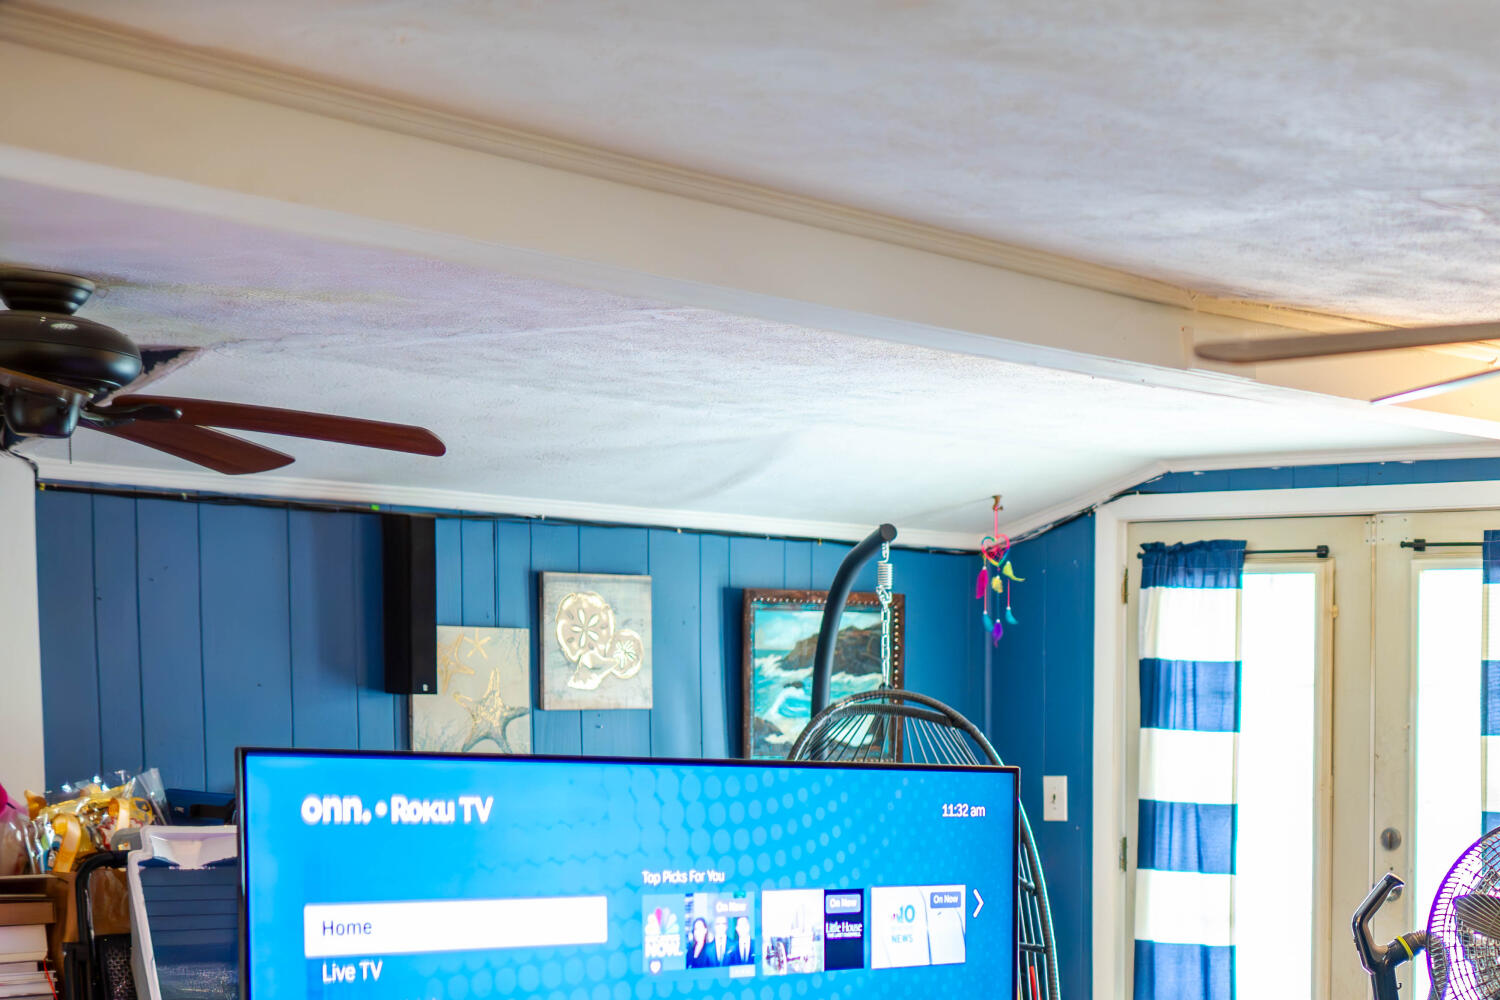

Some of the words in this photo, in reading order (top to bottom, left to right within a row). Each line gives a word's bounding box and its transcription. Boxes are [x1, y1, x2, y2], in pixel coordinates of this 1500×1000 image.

[300, 795, 372, 825] onn.
[390, 795, 456, 824] Roku
[458, 795, 495, 823] TV
[942, 803, 969, 818] 11:32
[970, 805, 986, 817] am
[642, 870, 661, 886] Top
[662, 870, 688, 883] Picks
[689, 870, 705, 882] For
[706, 870, 726, 882] You
[933, 894, 943, 904] On
[944, 893, 959, 903] Now
[322, 919, 373, 936] Home
[842, 921, 863, 932] House
[322, 963, 355, 984] Live
[358, 960, 383, 981] TV
